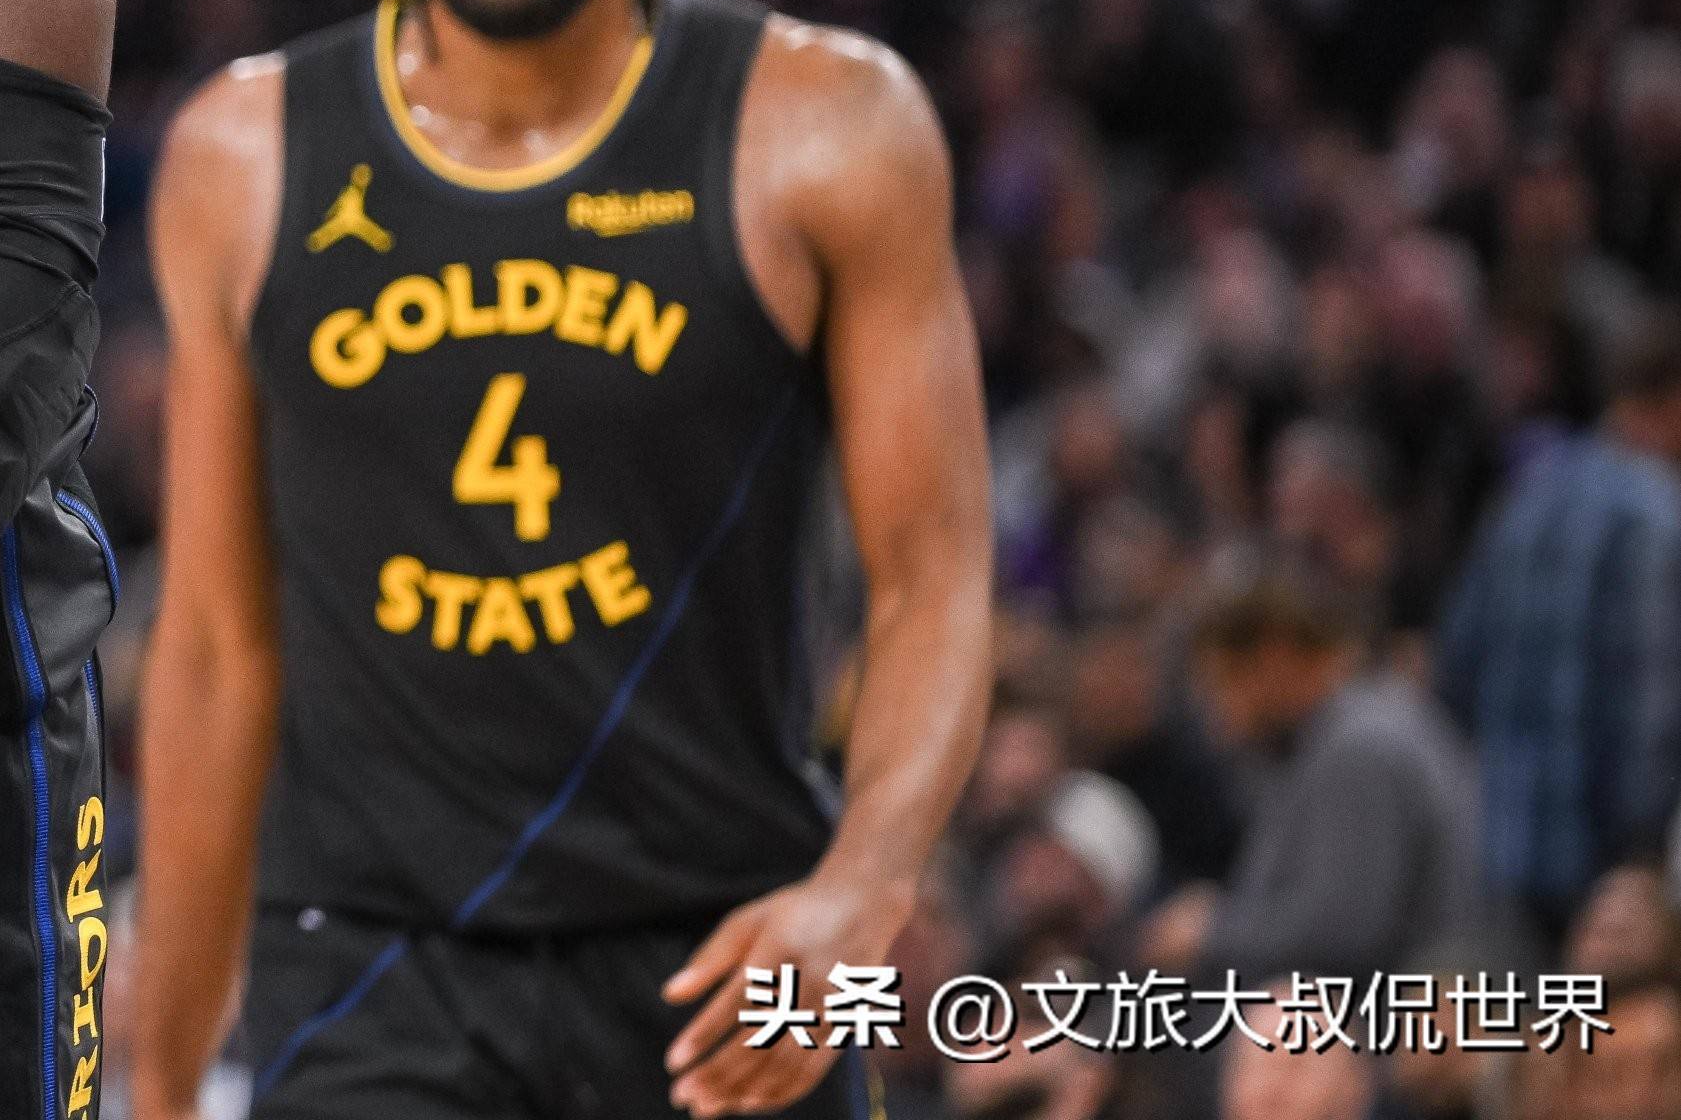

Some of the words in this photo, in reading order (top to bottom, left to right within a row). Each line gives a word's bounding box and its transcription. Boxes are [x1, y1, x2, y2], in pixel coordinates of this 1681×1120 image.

[309, 259, 688, 388] GOLDEN
[452, 372, 561, 542] 4
[375, 540, 651, 655] STATE
[67, 796, 107, 1120] RIORS
